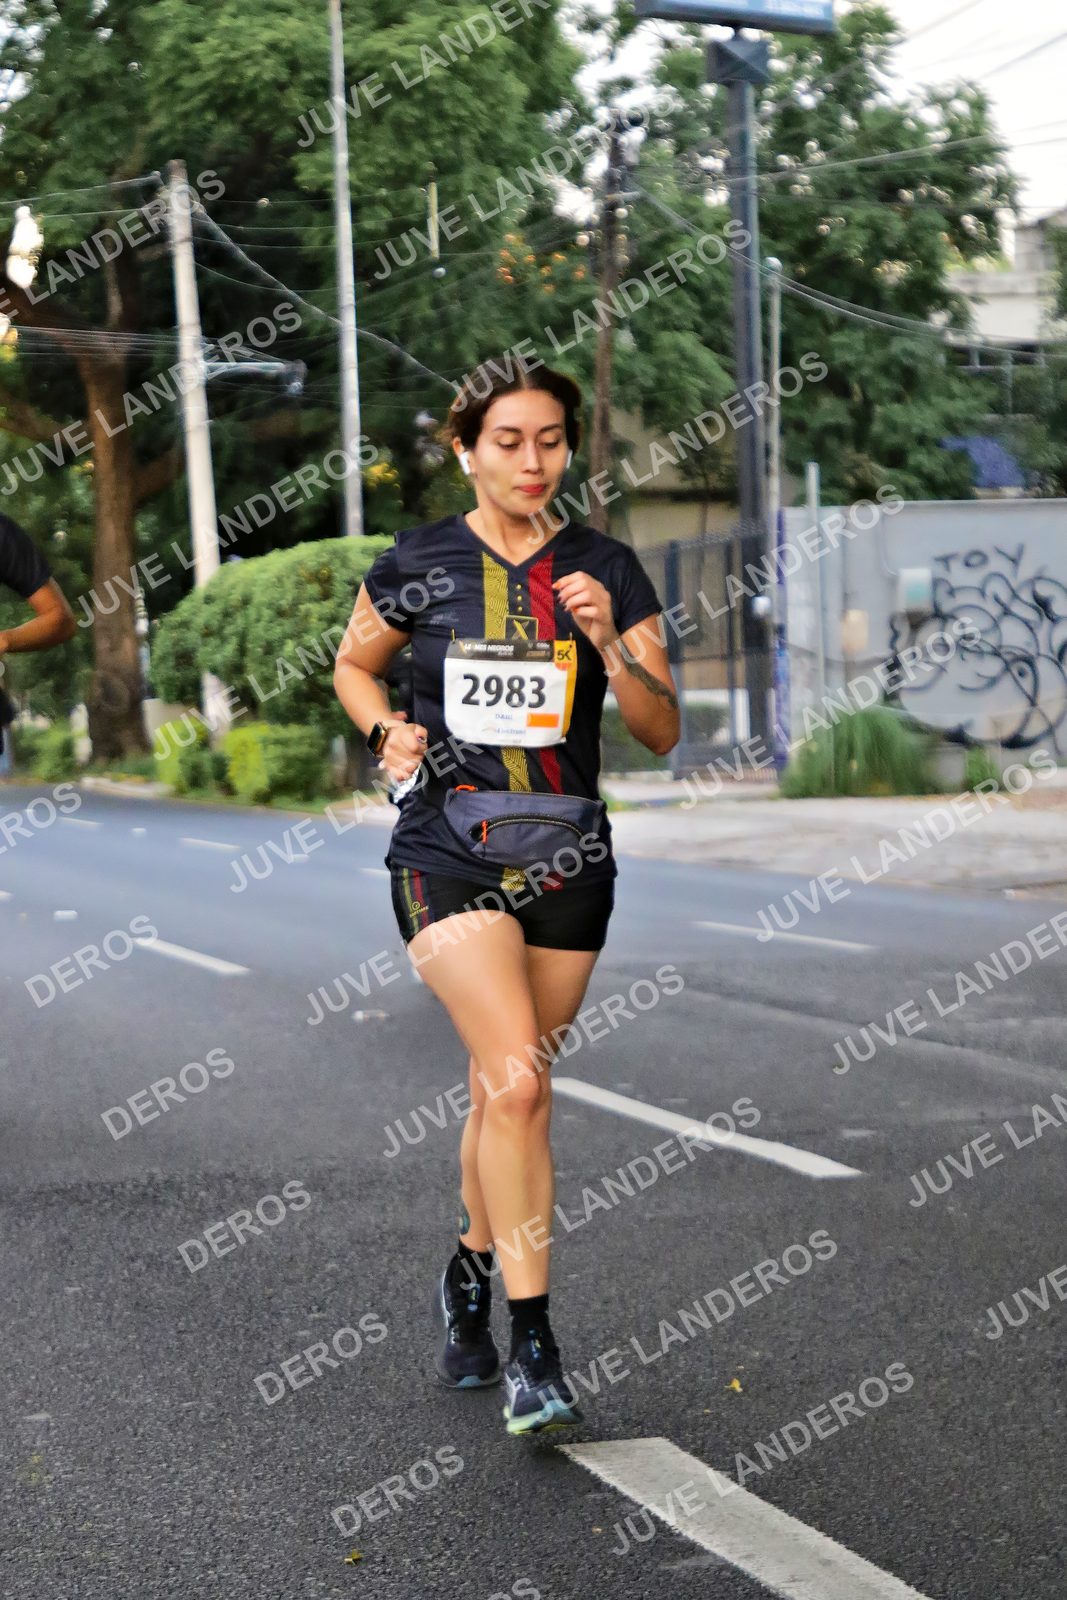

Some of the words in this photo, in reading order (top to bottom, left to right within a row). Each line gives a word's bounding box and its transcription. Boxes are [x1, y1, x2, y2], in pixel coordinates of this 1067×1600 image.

[933, 543, 1024, 577] TOY
[557, 649, 572, 661] 5K
[461, 673, 546, 708] 2983
